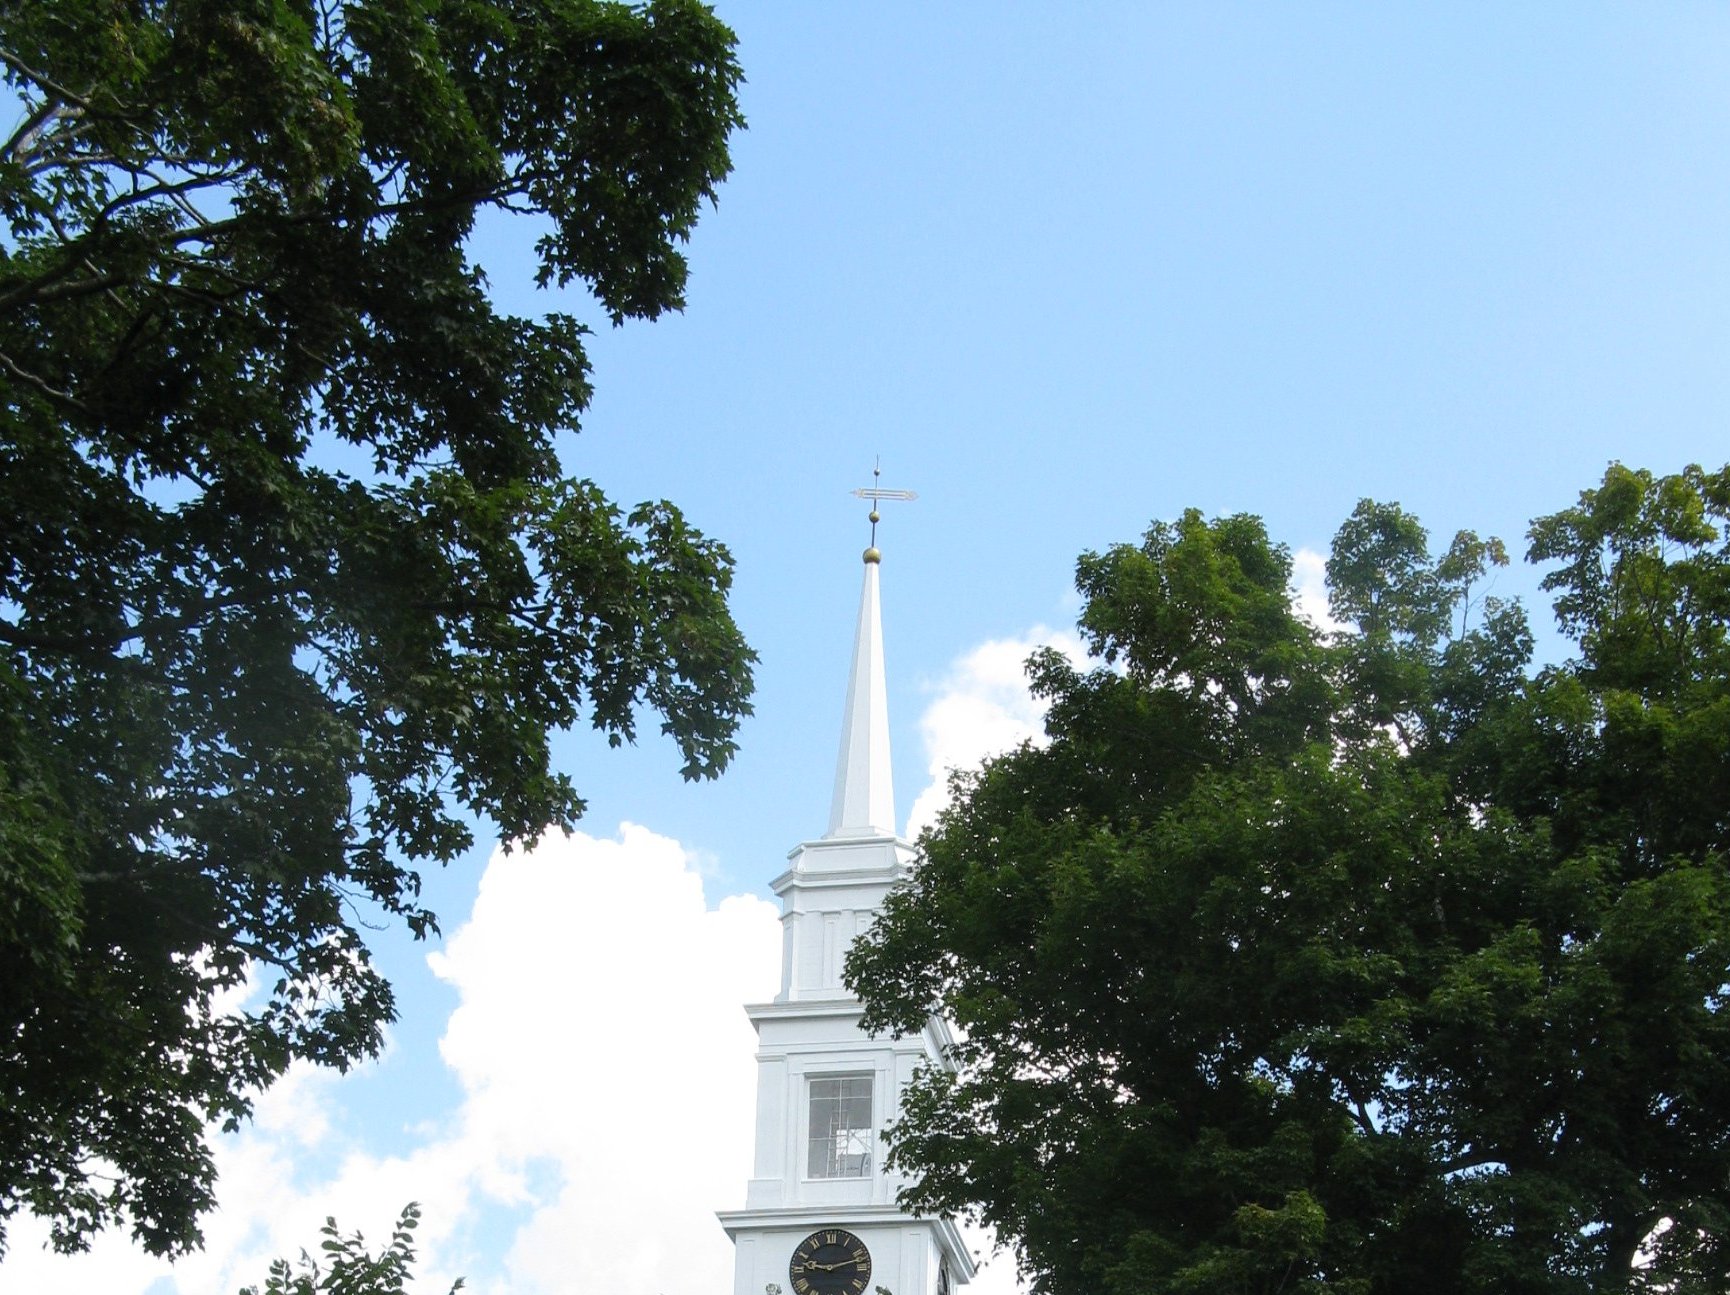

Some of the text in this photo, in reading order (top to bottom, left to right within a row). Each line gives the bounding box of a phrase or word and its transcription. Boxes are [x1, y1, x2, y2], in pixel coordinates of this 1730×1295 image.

[809, 1237, 820, 1249] XI
[825, 1232, 837, 1244] XII
[843, 1236, 851, 1247] I
[856, 1262, 867, 1271] III
